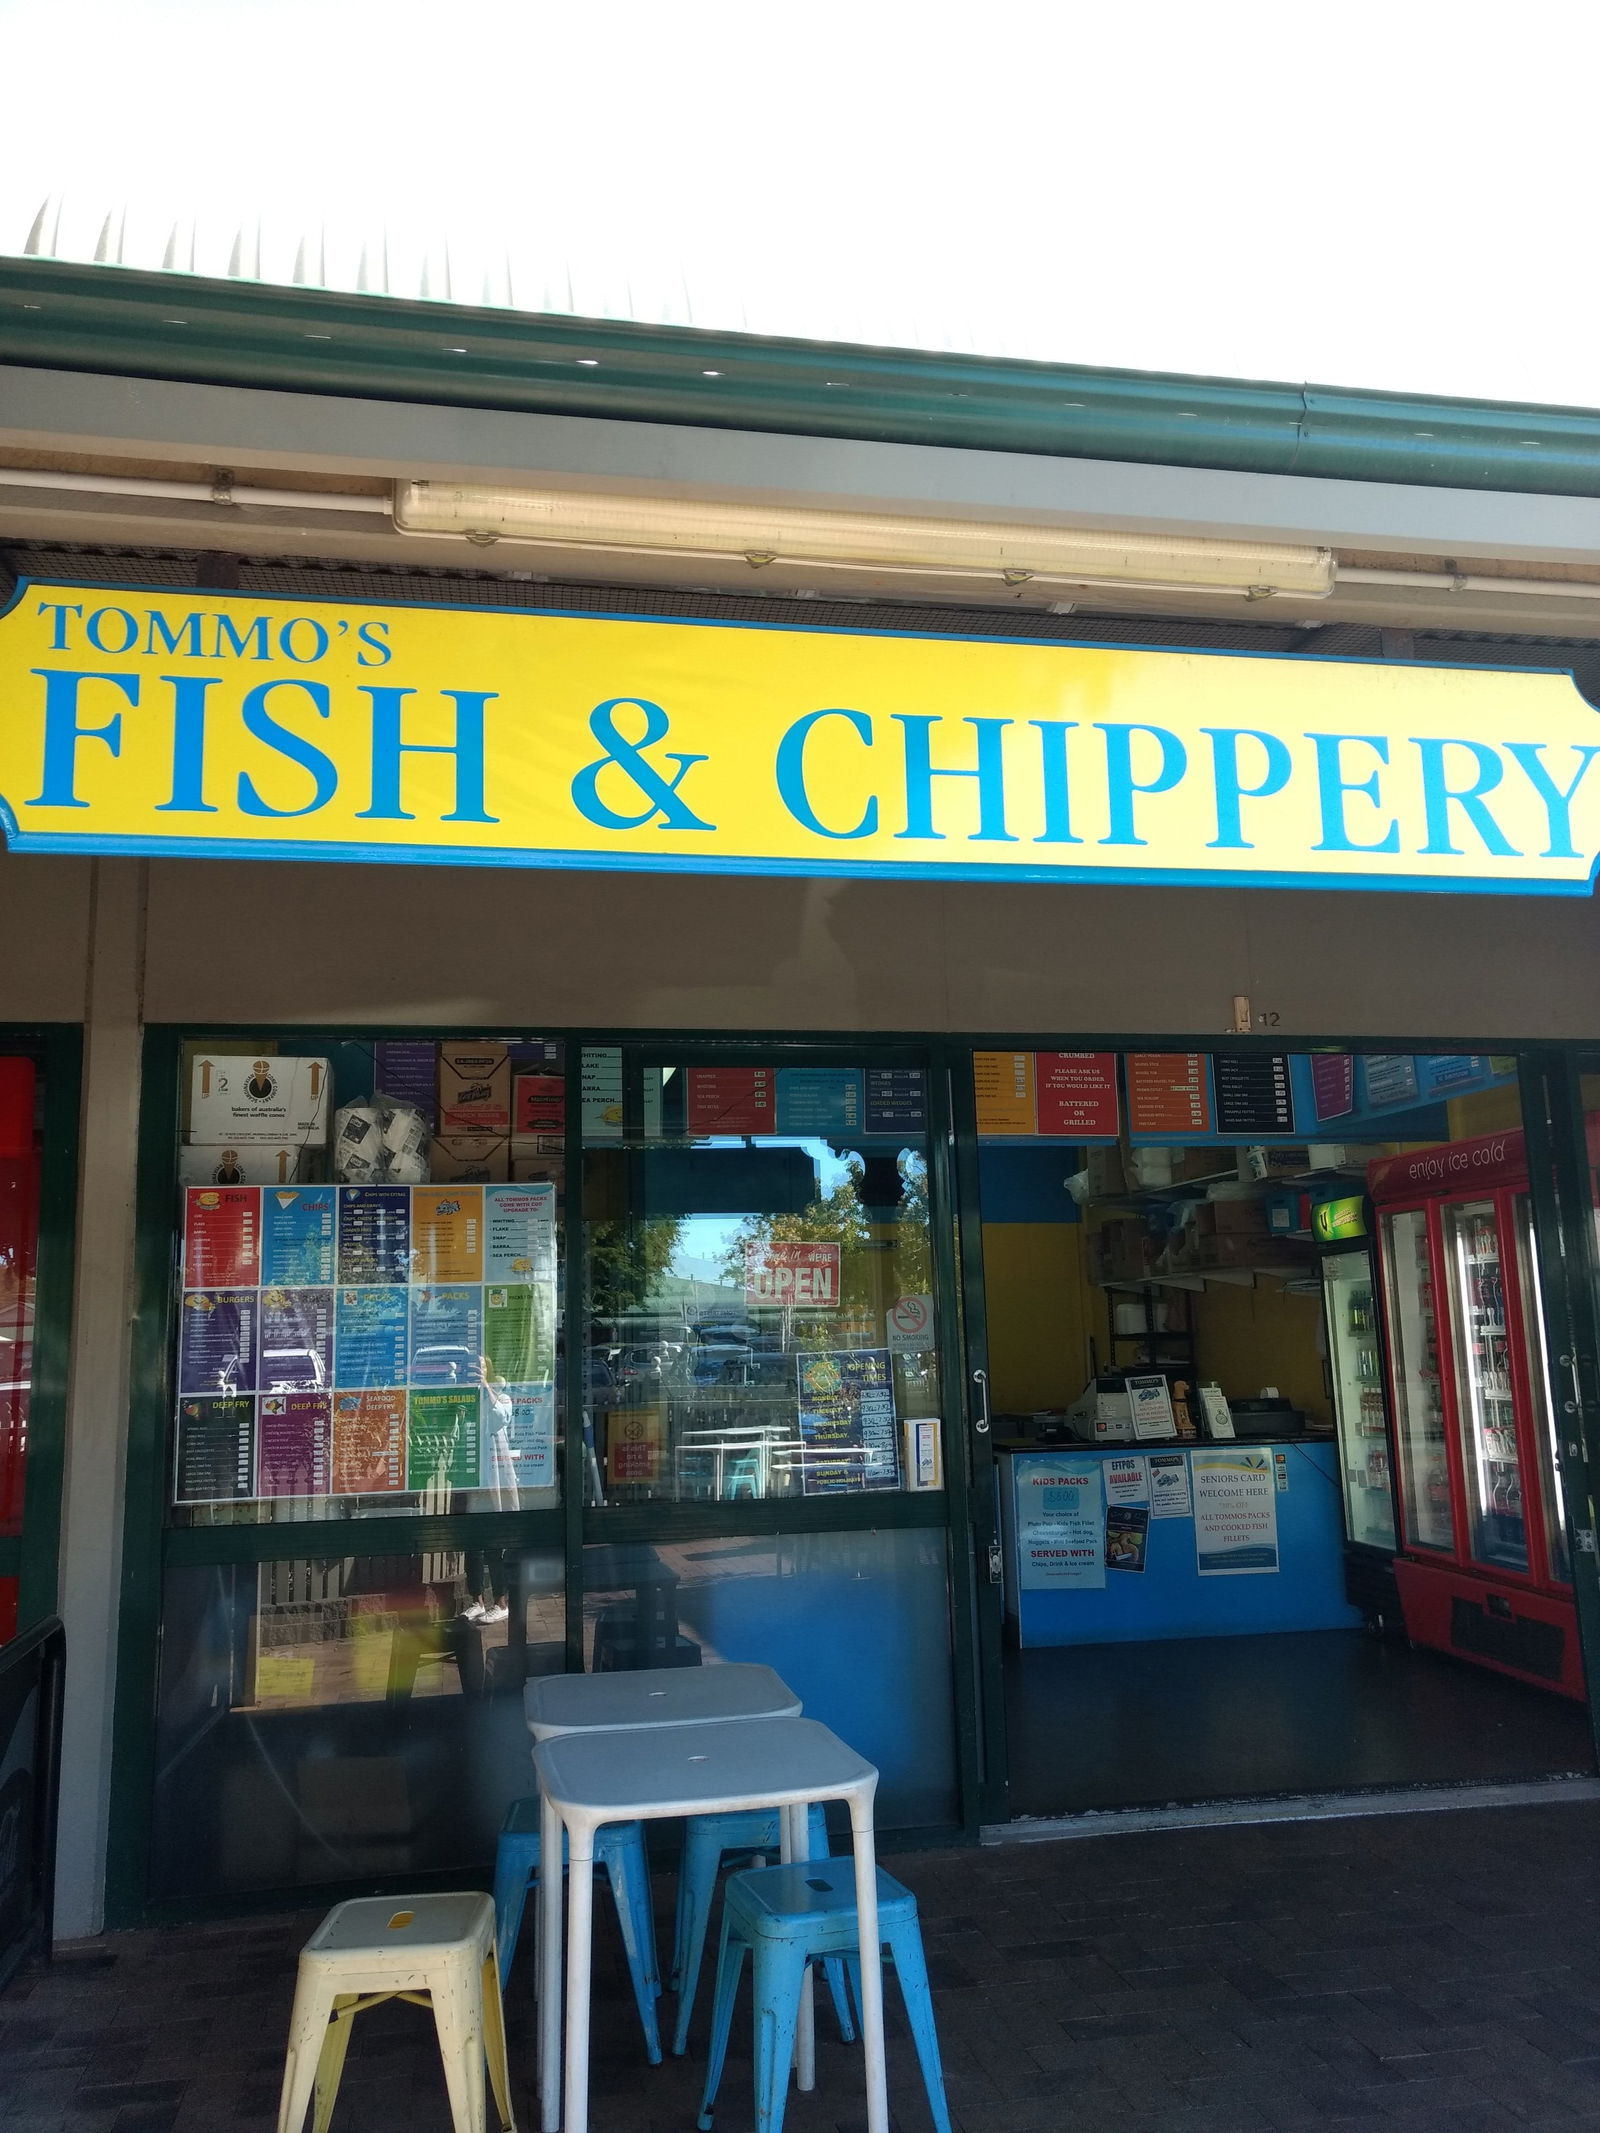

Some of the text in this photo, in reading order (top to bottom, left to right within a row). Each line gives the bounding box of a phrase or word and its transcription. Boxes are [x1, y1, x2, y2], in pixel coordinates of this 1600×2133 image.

[38, 602, 393, 668] TOMMO'S
[25, 668, 1600, 859] FISH & CHIPPERY
[1261, 1012, 1281, 1026] 12
[1057, 1052, 1095, 1060] CRUMBED
[1409, 1139, 1506, 1181] enjoy ice cold
[224, 1194, 248, 1202] FISH
[302, 1203, 329, 1212] CHIPS
[808, 1253, 832, 1263] WE'RE
[754, 1268, 832, 1299] OPEN
[217, 1295, 255, 1305] BURGERS
[847, 1361, 886, 1371] OPENING
[861, 1373, 887, 1382] TIMES
[366, 1395, 396, 1403] SEAFOOD
[415, 1394, 476, 1405] TOMMO'S SALADS
[213, 1400, 250, 1410] DEEP FRY
[1111, 1459, 1135, 1471] EFTPOS
[1032, 1477, 1089, 1486] KIDS PACKS
[1108, 1472, 1143, 1484] AVAILABLE
[1200, 1473, 1266, 1484] SENIORS CARD
[1199, 1487, 1269, 1499] WELCOME HERE
[1215, 1513, 1247, 1521] TOMMOS
[1204, 1524, 1220, 1532] AND
[1223, 1534, 1250, 1543] FILLETS
[1030, 1548, 1095, 1558] SERVED WITH
